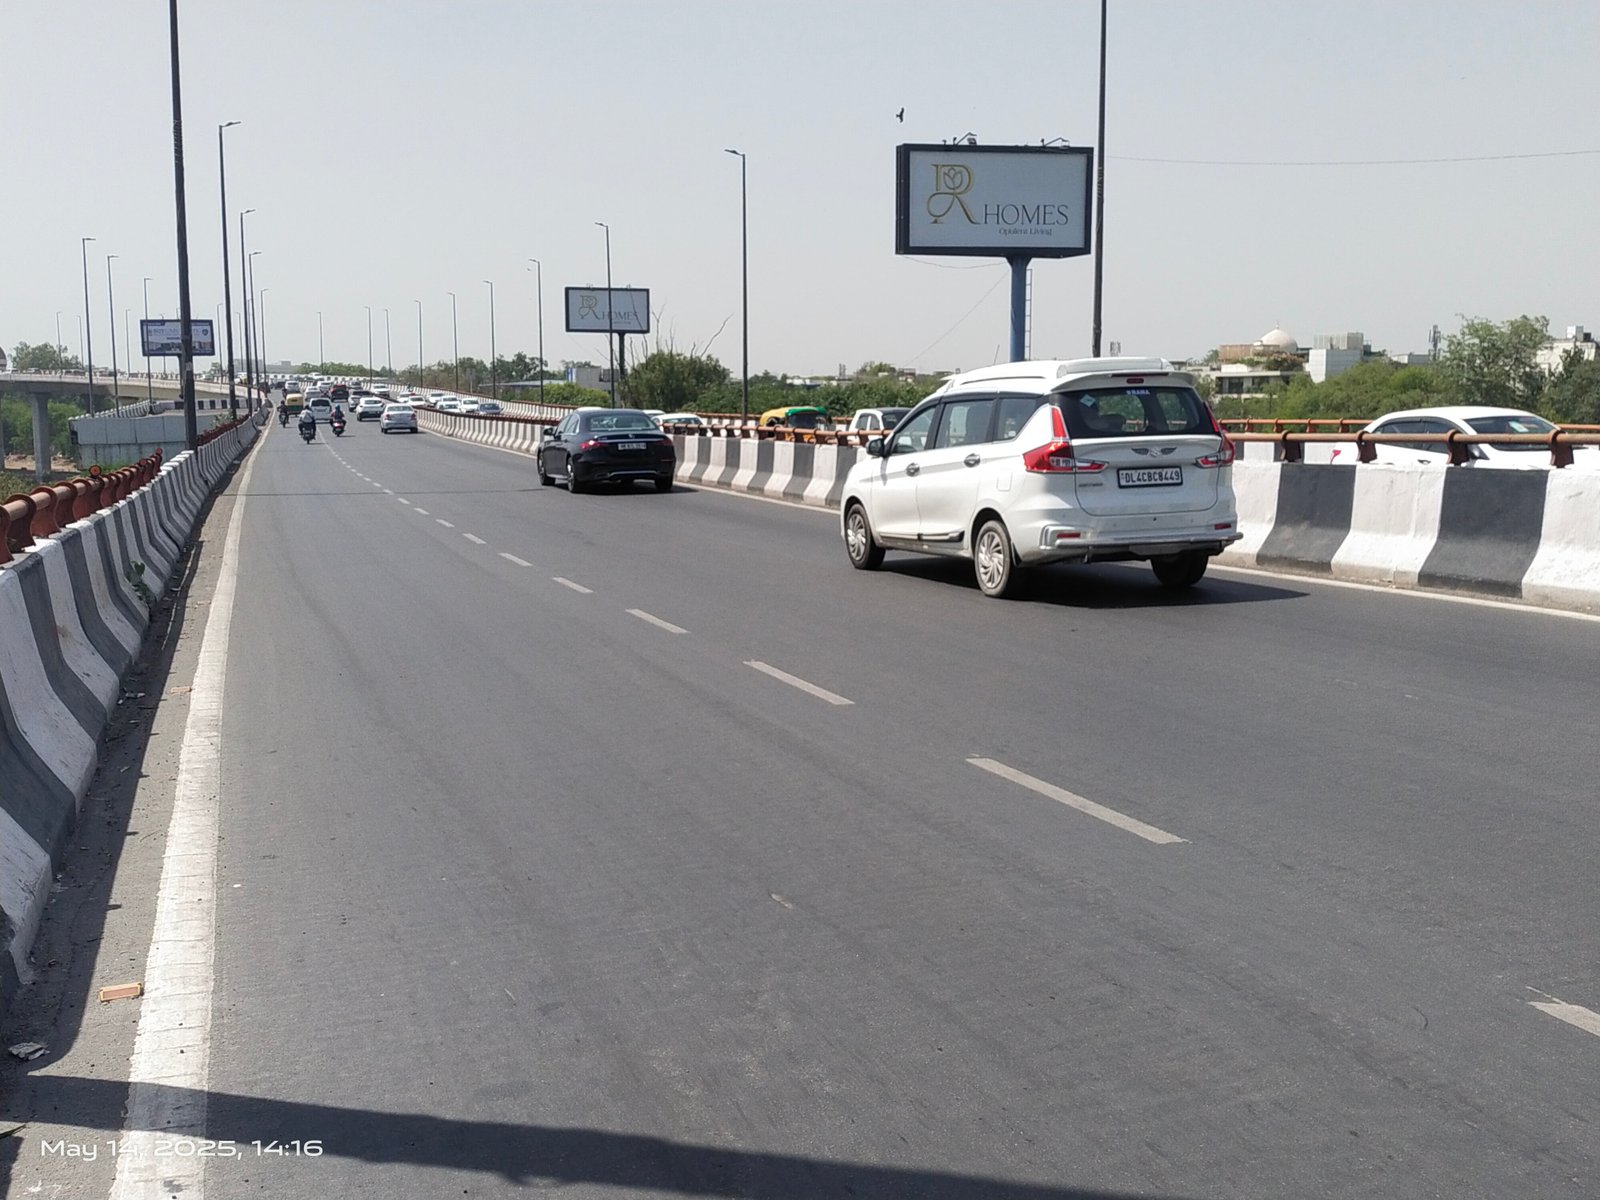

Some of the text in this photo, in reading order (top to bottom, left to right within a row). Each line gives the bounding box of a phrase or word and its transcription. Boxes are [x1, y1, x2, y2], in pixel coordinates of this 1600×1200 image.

[984, 204, 1069, 226] HOMES
[998, 227, 1053, 237] Opulent Living
